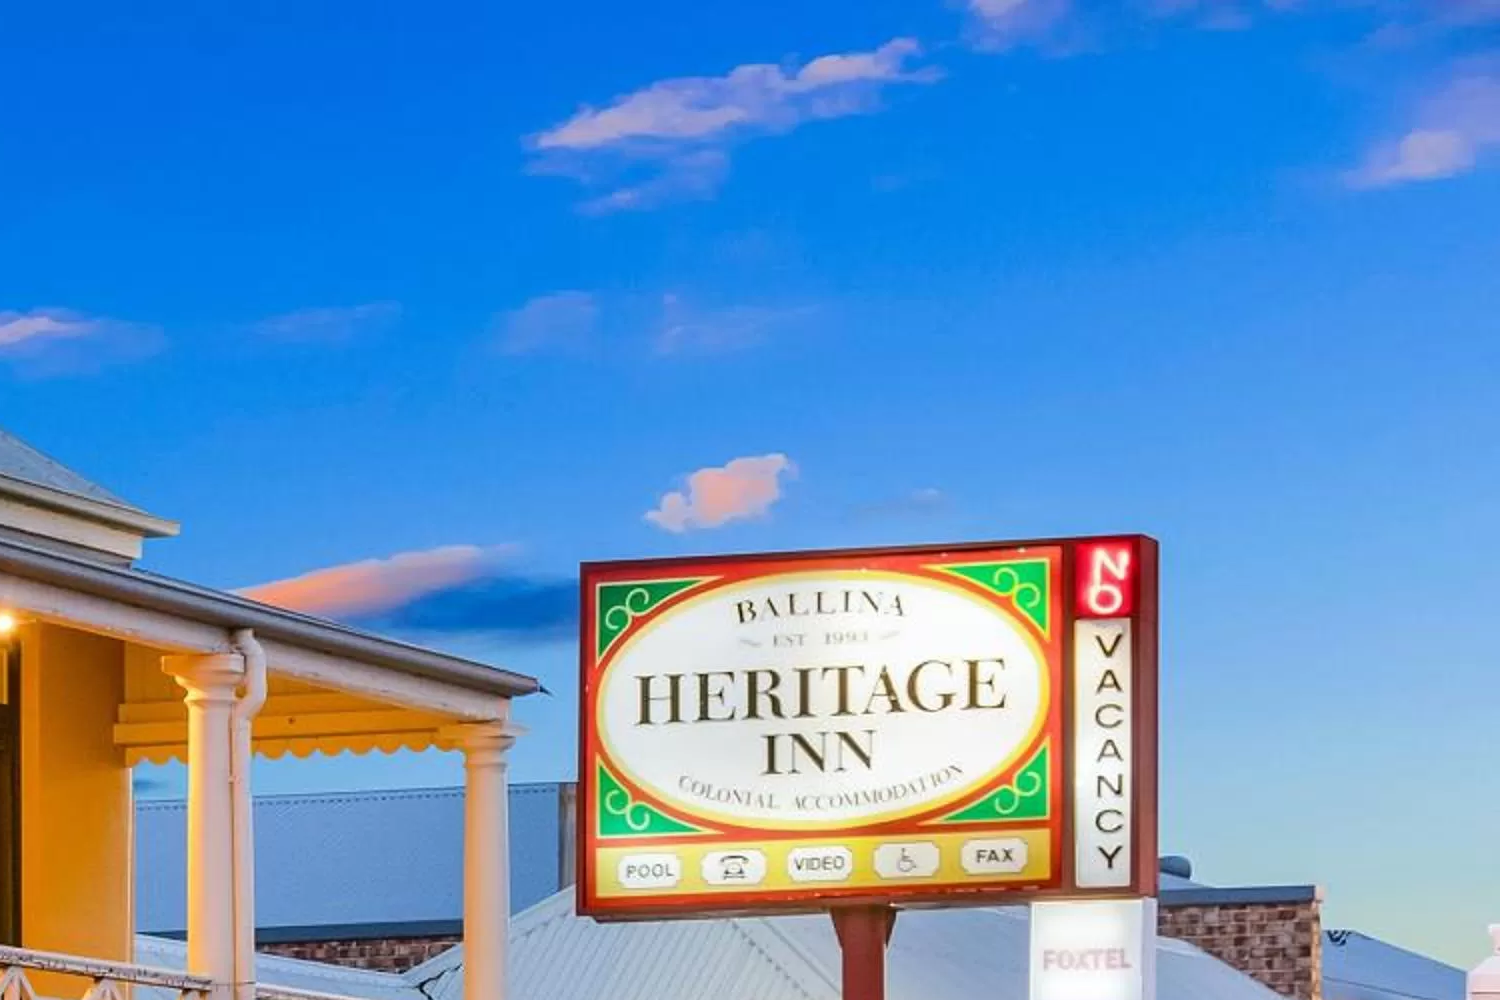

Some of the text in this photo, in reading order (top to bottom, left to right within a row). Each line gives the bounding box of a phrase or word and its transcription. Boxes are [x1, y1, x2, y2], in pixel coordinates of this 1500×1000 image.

[1089, 547, 1128, 615] NO
[735, 590, 905, 624] BALLINA
[773, 632, 806, 648] EST
[633, 657, 1008, 726] HERITAGE
[760, 729, 877, 775] INN
[1095, 633, 1124, 869] VACANCY
[677, 763, 964, 811] COLONIAL ACCOMMODATION
[625, 863, 675, 880] POOL
[793, 855, 846, 872] VIDEO
[975, 848, 1015, 864] FAX
[1043, 948, 1133, 971] FOXTEL
